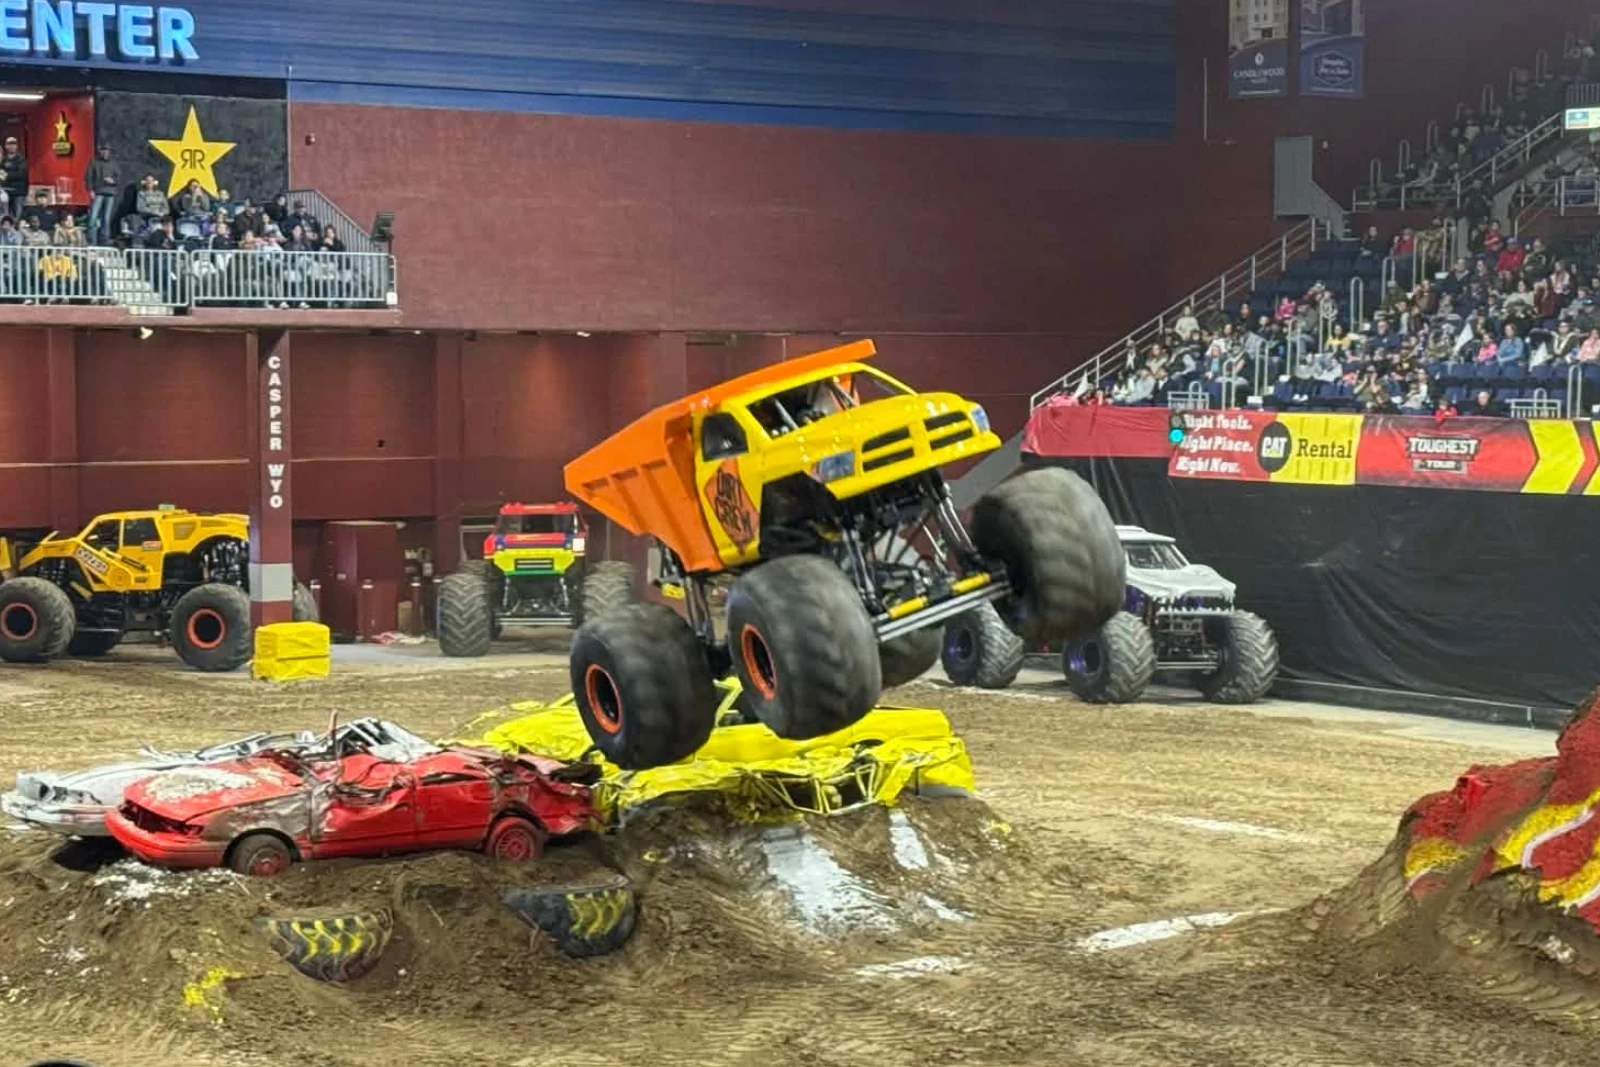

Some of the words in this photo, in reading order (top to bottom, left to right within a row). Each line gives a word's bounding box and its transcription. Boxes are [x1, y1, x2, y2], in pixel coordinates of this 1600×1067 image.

[0, 0, 199, 59] ENTER
[268, 356, 282, 450] CASPER
[1261, 436, 1287, 458] CAT
[1296, 438, 1352, 459] Rental
[1408, 437, 1478, 455] TOUGHEST
[268, 464, 284, 508] WYO
